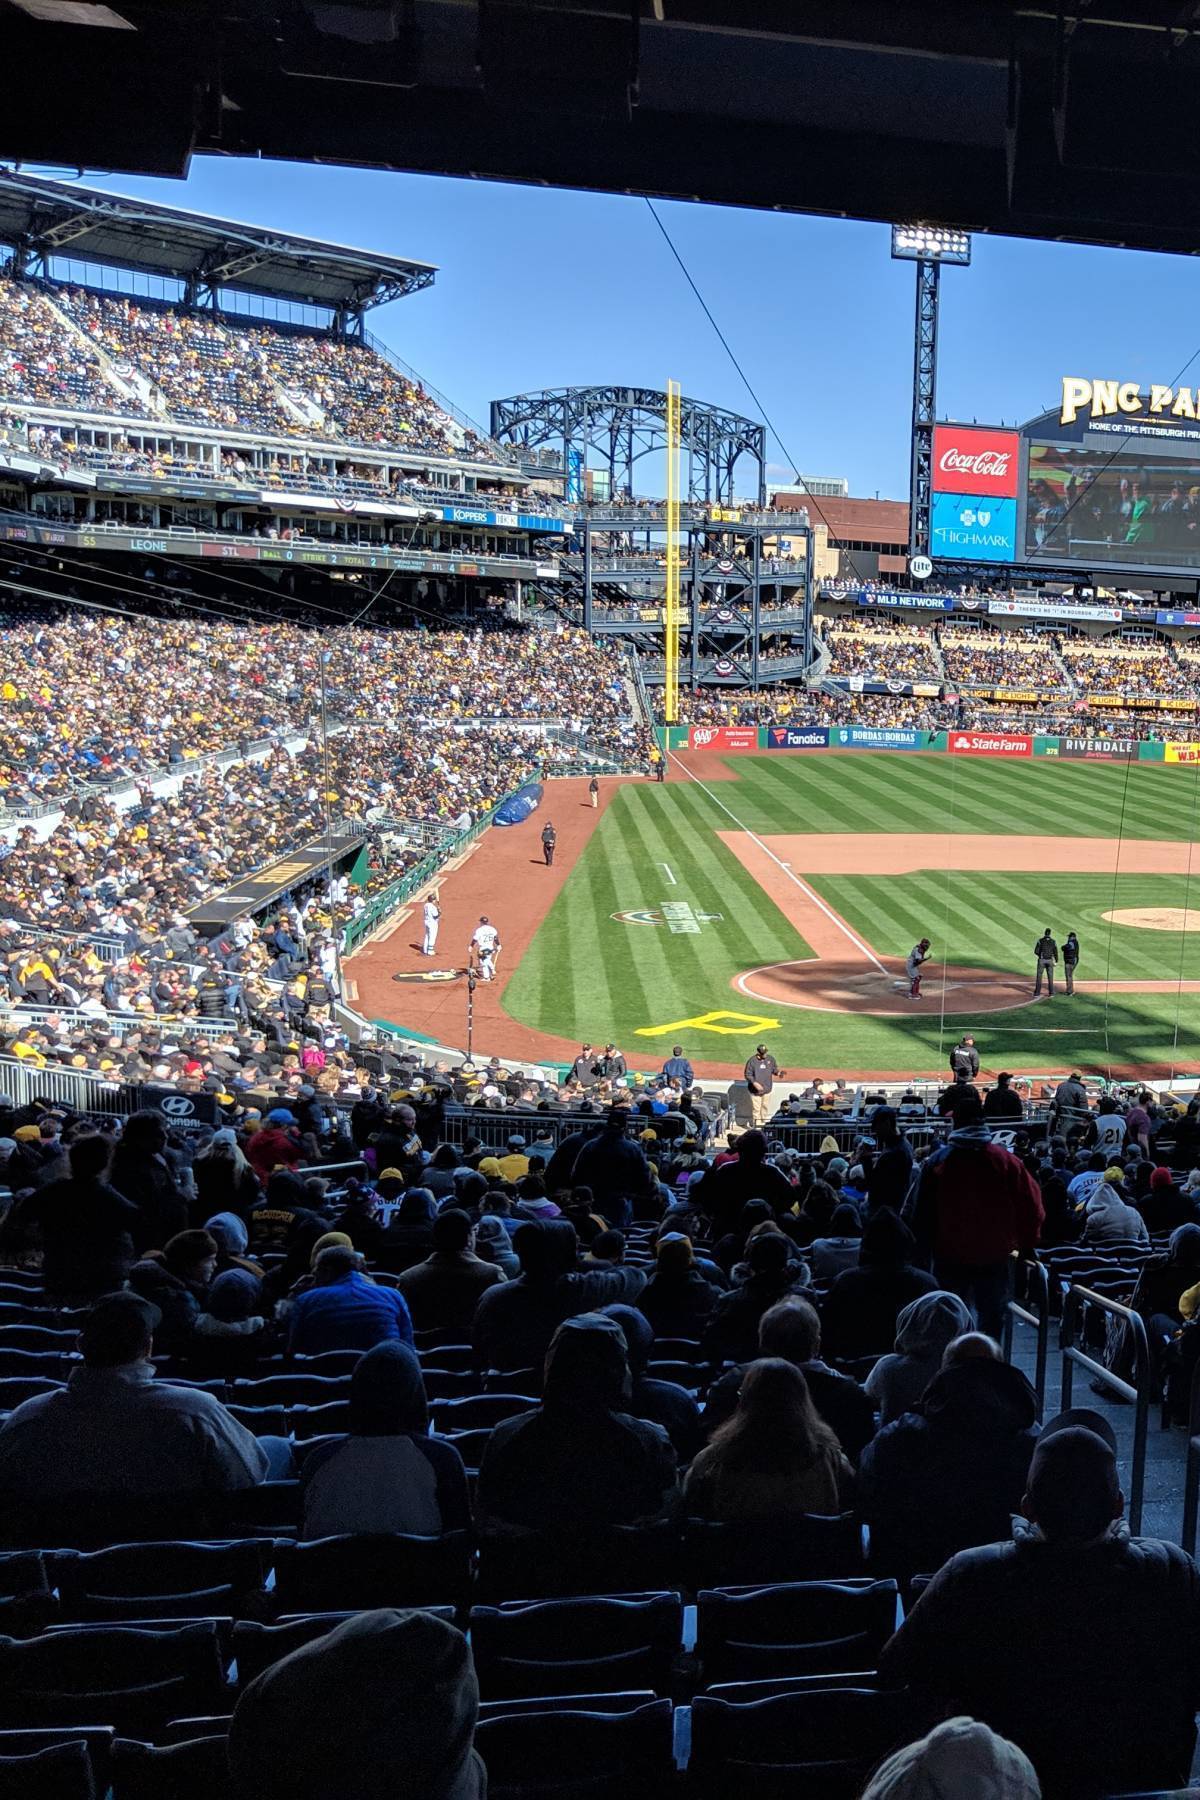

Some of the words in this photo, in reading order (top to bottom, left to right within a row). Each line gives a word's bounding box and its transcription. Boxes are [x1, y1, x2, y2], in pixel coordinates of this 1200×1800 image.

[1060, 377, 1143, 425] PNC
[1089, 421, 1111, 432] HOME
[1112, 424, 1122, 432] OF
[1123, 424, 1139, 434] THE
[1139, 426, 1187, 438] PITTSBURGH
[940, 448, 1013, 477] Coca-Cola
[453, 508, 488, 522] KOPPERS
[83, 536, 97, 546] 55
[935, 528, 1011, 548] HIGHMARK
[131, 539, 168, 551] LEONE
[222, 547, 239, 557] STL
[286, 550, 293, 560] 0
[330, 554, 338, 564] 2
[344, 556, 366, 566] TOTAL
[370, 557, 377, 567] 2
[432, 563, 443, 571] STL
[913, 560, 931, 572] Lite
[877, 595, 898, 605] MLB
[900, 596, 945, 608] NETWORK
[971, 690, 992, 698] LIGHT
[1051, 694, 1072, 702] LIGHT
[1137, 699, 1156, 707] LIGHT
[788, 732, 826, 745] Fanatics
[852, 730, 882, 741] BORDAS
[885, 731, 916, 743] BORDAS
[1066, 739, 1133, 753] RIVENDALE
[1104, 1128, 1120, 1144] 21
